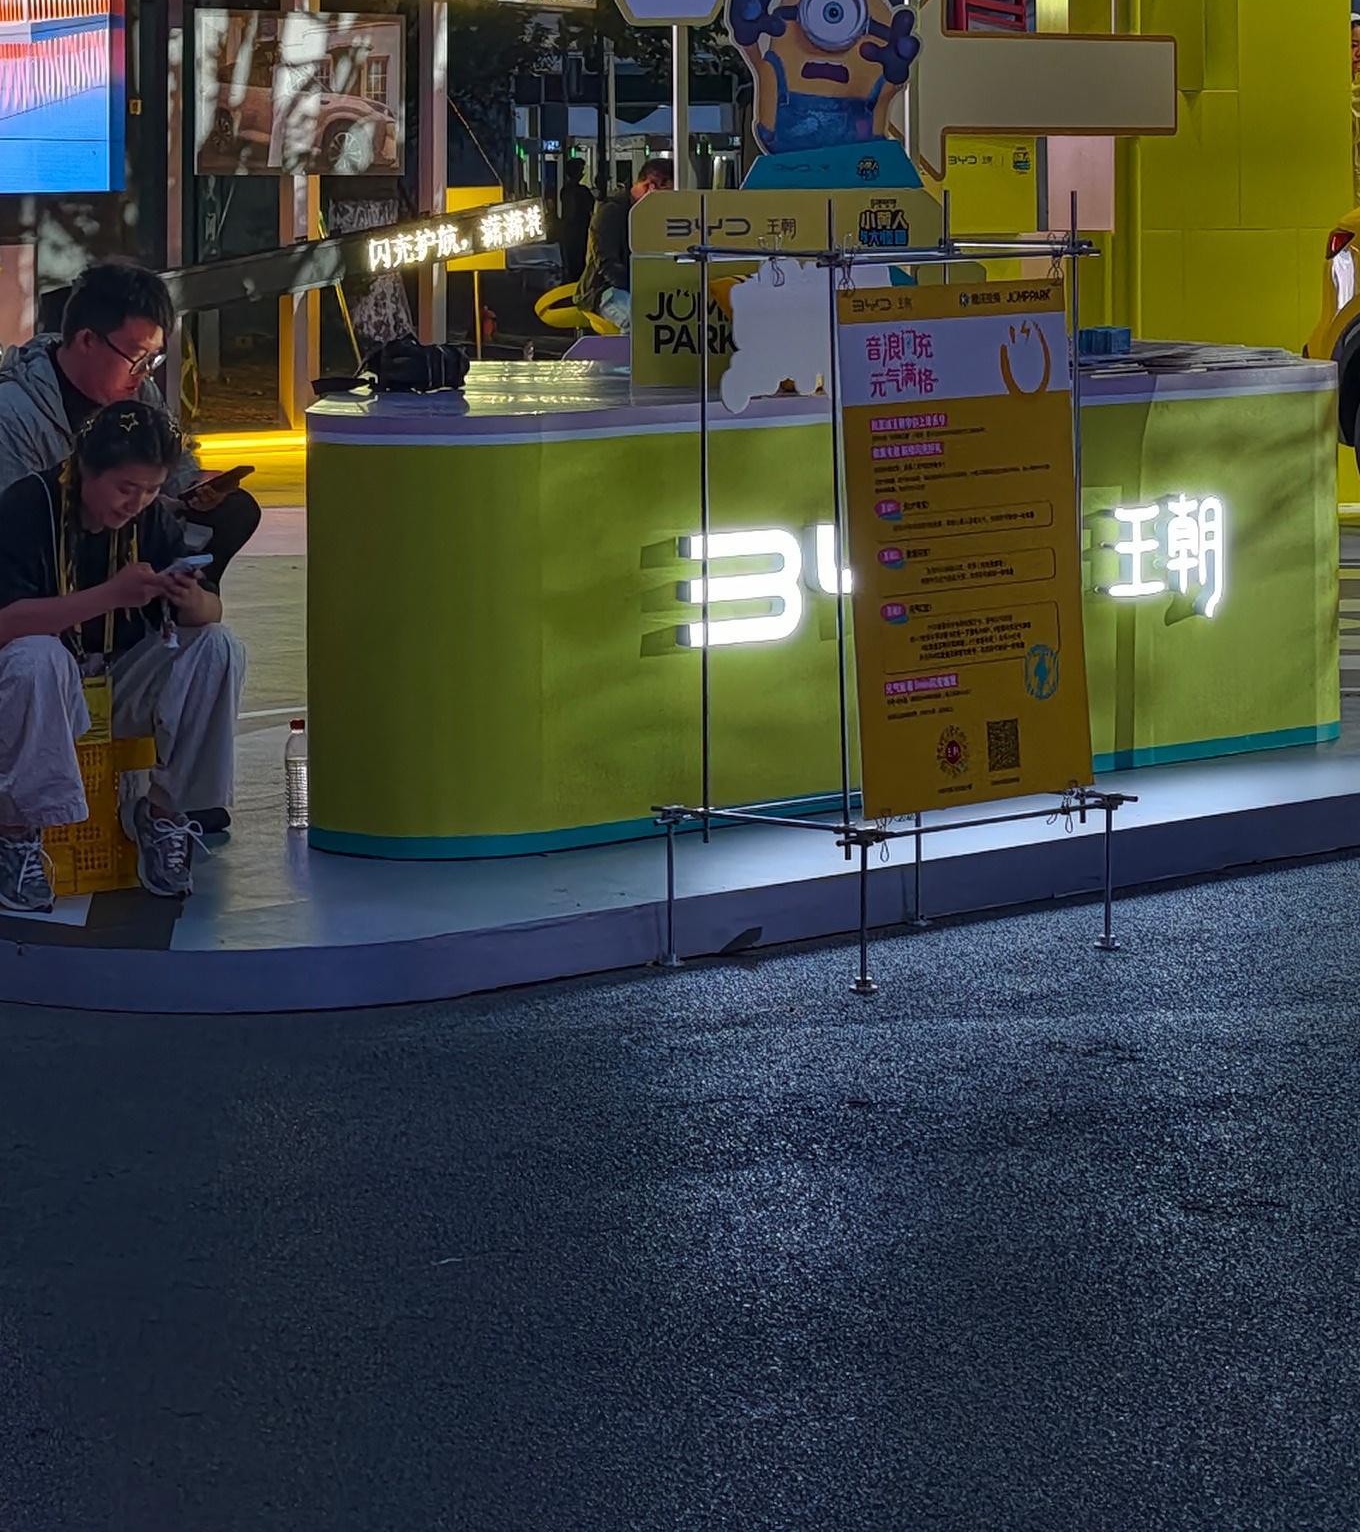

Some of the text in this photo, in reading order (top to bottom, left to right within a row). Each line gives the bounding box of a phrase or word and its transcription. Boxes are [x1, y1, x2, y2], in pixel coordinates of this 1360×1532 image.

[666, 217, 797, 240] BYD 王朝
[646, 289, 729, 323] JUM
[654, 324, 740, 355] PARK
[870, 363, 939, 398] 元气满格
[1104, 494, 1226, 619] 王朝
